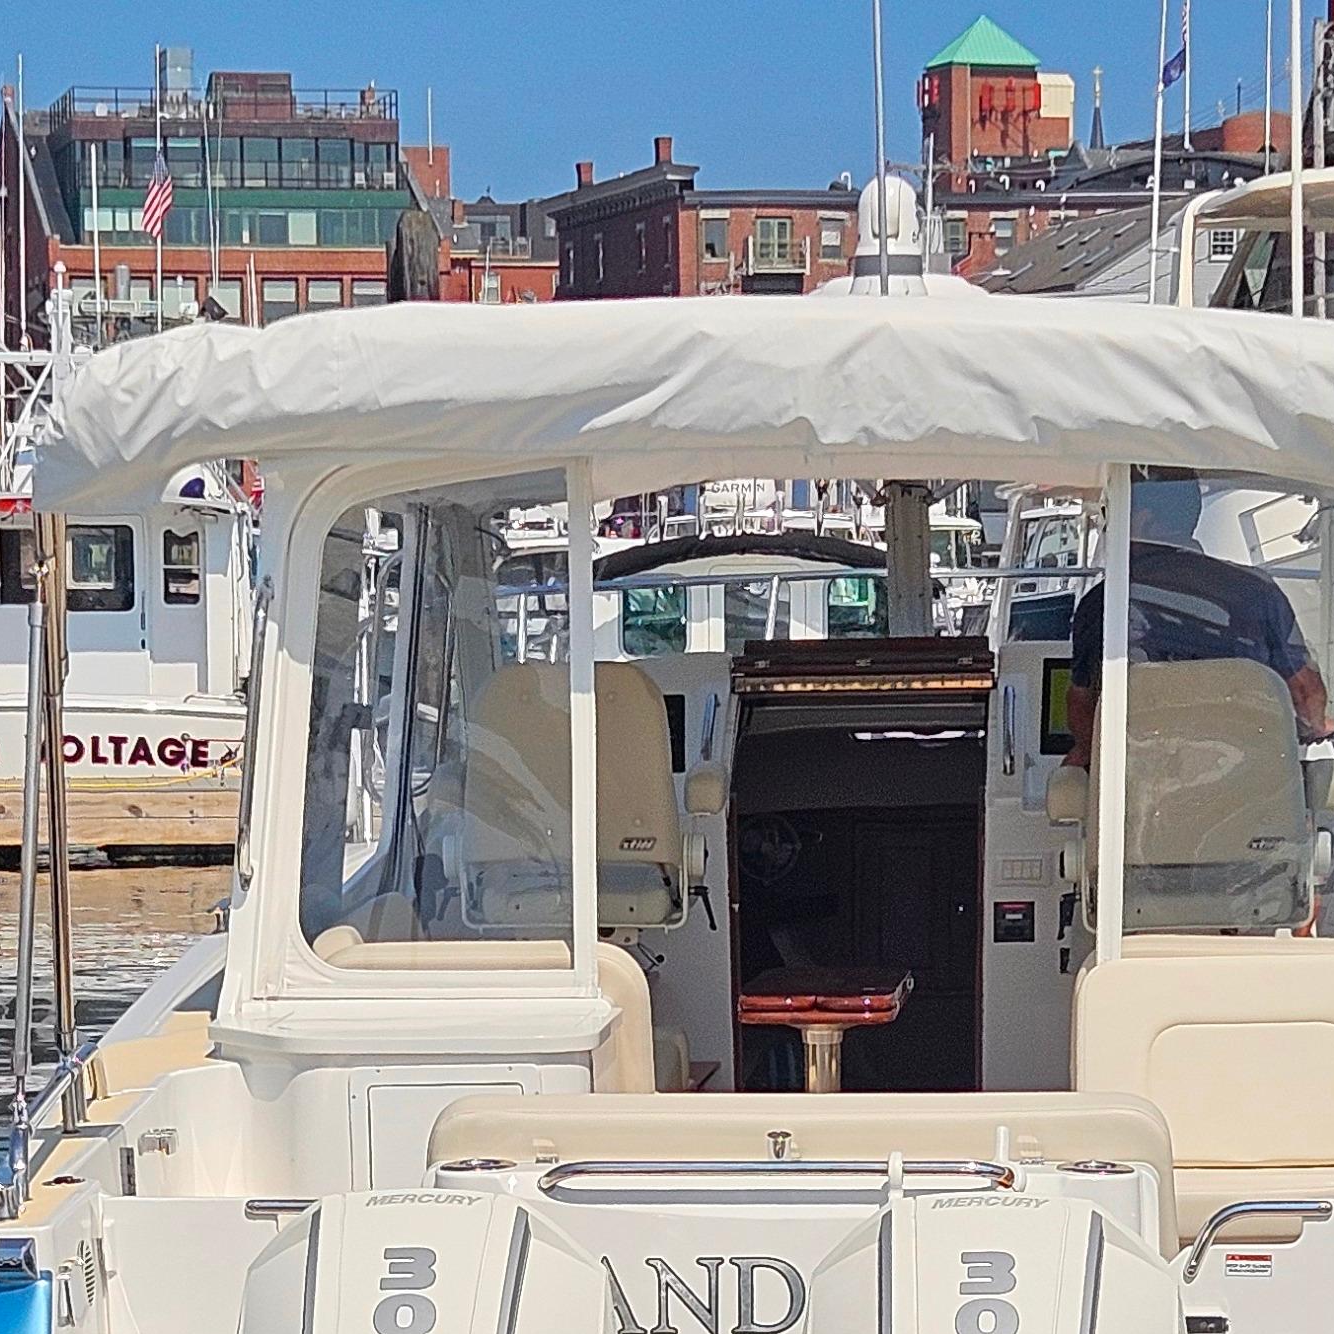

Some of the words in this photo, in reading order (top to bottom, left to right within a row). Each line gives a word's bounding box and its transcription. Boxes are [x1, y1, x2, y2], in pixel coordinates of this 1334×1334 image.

[37, 733, 211, 768] OLTAGE
[365, 1192, 485, 1208] MERCURY
[930, 1195, 1051, 1210] MERCURY
